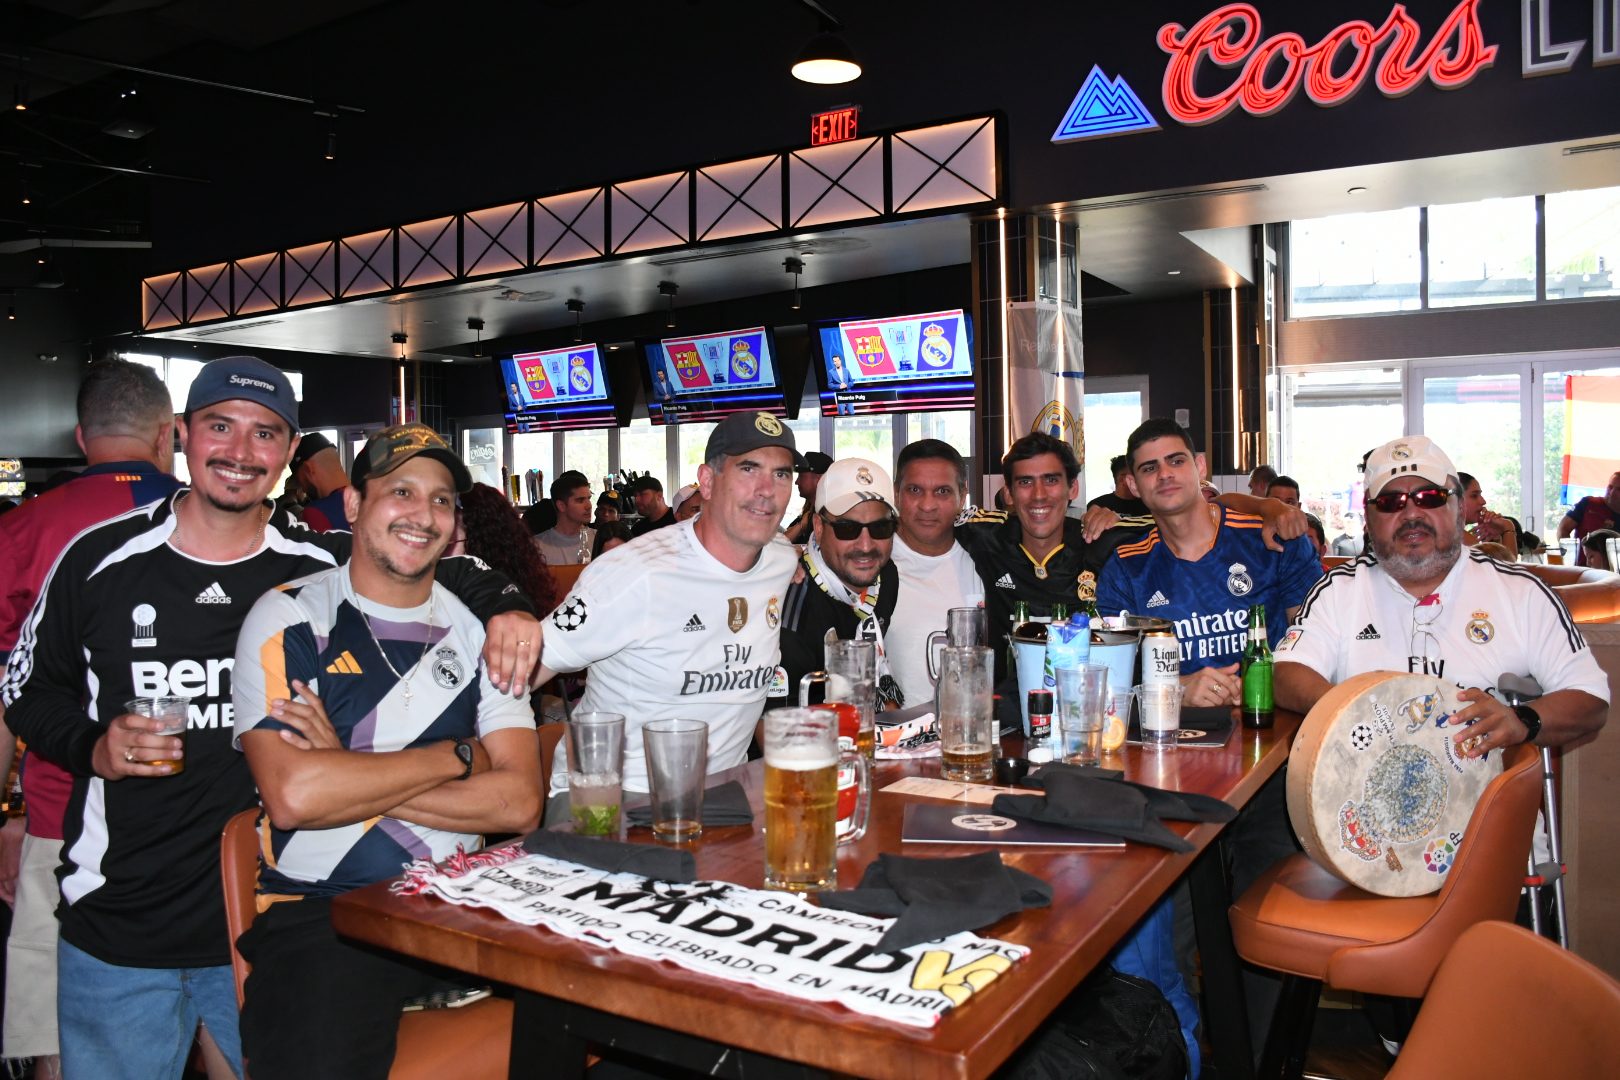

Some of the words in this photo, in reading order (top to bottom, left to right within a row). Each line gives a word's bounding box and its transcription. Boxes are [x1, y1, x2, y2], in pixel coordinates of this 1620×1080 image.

[1156, 0, 1499, 125] Coors
[819, 111, 852, 143] EXIT
[229, 374, 275, 392] Supreme
[995, 581, 1016, 590] adidas
[195, 596, 232, 604] adidas
[1146, 599, 1170, 608] adidas
[1174, 608, 1251, 639] mirate
[723, 643, 752, 665] Fly
[1179, 641, 1193, 661] LY
[1198, 632, 1248, 659] BETTER
[1408, 656, 1445, 679] Fly
[1449, 831, 1464, 847] FP
[563, 881, 914, 974] MADRID
[524, 900, 622, 930] PARTIDO
[626, 929, 778, 976] CELEBRADO
[788, 972, 832, 989] EN
